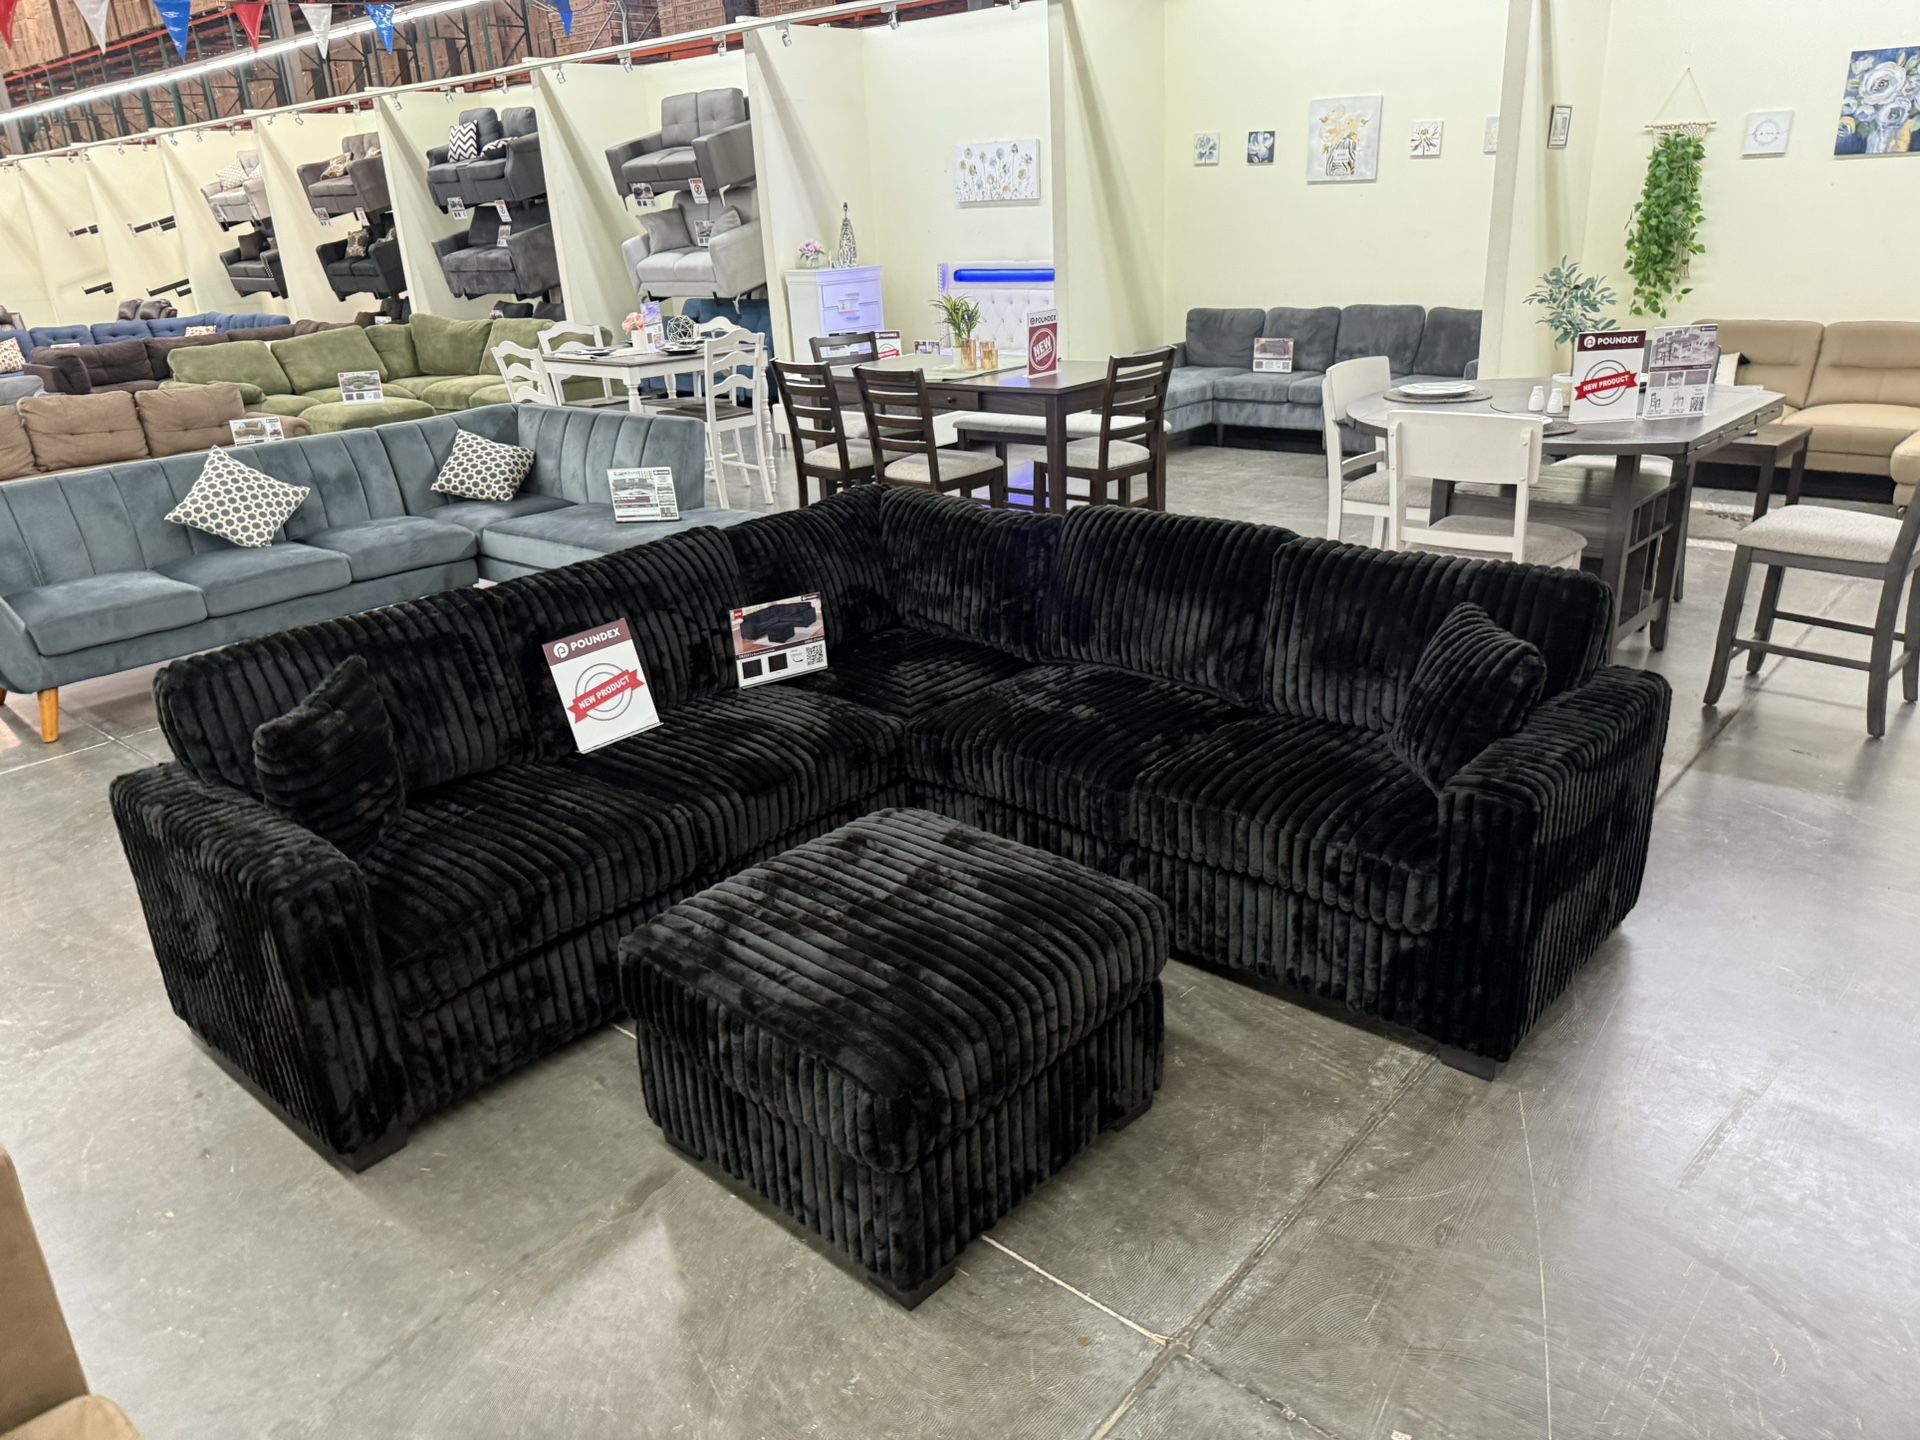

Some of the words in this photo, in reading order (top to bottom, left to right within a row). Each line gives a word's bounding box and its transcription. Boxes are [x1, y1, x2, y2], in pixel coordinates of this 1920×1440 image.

[1033, 335, 1052, 357] NEW
[1597, 335, 1639, 346] POUNDEX
[1583, 383, 1597, 392] NEW
[1599, 375, 1629, 389] PRODUCT
[570, 627, 621, 651] POUNDEX
[578, 694, 596, 710] NEW
[596, 675, 630, 699] PRODUCT
